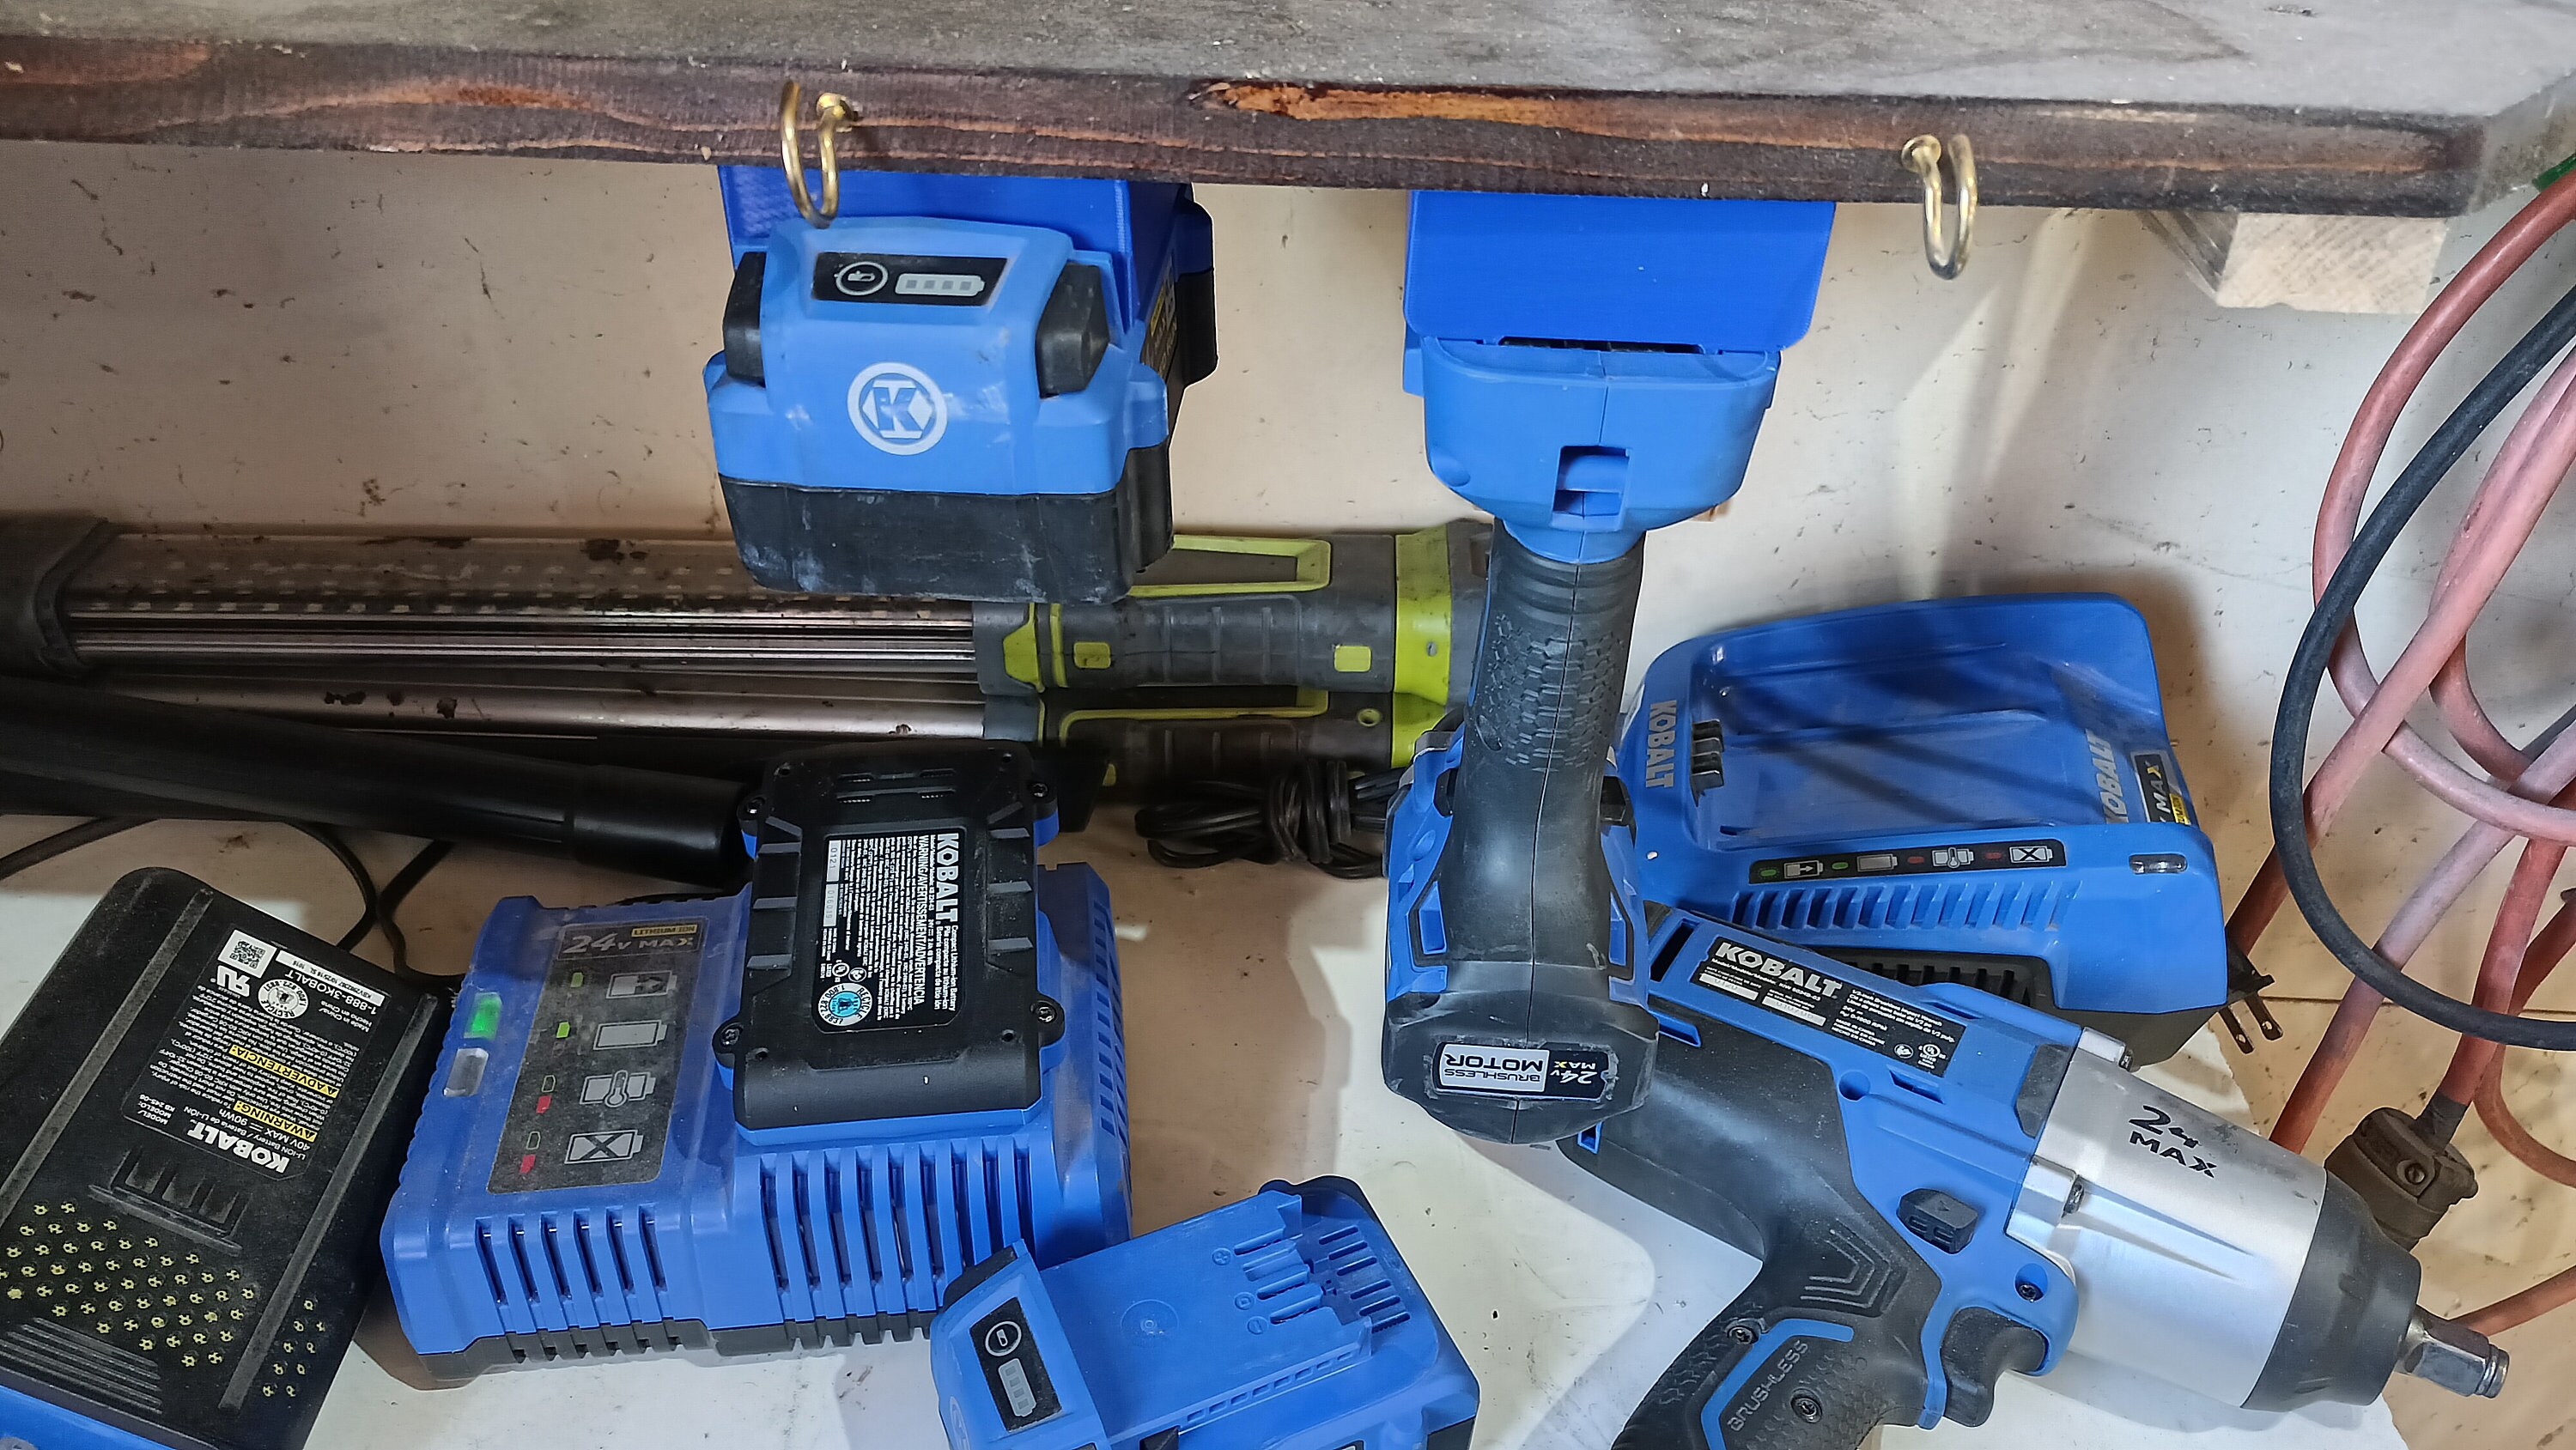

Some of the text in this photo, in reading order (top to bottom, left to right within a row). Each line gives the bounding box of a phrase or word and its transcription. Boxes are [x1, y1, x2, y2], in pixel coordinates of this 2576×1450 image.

[1644, 699, 1677, 789] KOBALT
[2145, 761, 2171, 814] MAX
[829, 846, 837, 871] 0121
[934, 833, 958, 924] KOBALT
[913, 834, 929, 1004] WARNING/AVERTISSEMENT/ADVERTENCIA
[639, 937, 694, 949] MAX
[933, 947, 943, 977] compacta
[948, 925, 958, 1011] Compact Lithium-ion Battery
[1715, 941, 1844, 999] KOBALT
[934, 977, 942, 986] de
[283, 968, 379, 1016] 1-888-3KOBALT
[260, 999, 295, 1016] RECYCLE
[319, 999, 341, 1013] China
[817, 985, 844, 1023] 1.800.822.8837
[856, 988, 871, 1018] RECYCLE
[318, 1005, 343, 1021] China/
[349, 1013, 372, 1027] Hecho
[349, 1019, 369, 1032] Made
[156, 1059, 168, 1068] Do
[185, 1059, 212, 1073] between
[195, 1056, 206, 1065] Do
[212, 1057, 232, 1068] above
[221, 1053, 240, 1065] reach
[1443, 1053, 1544, 1072] MOTOR
[1553, 1060, 1596, 1071] MAX
[224, 1068, 238, 1077] and
[230, 1045, 325, 1091] ADVERTENCIA:
[231, 1065, 246, 1074] heat
[256, 1068, 280, 1082] battery
[149, 1063, 235, 1102] user must read the instruction
[197, 1077, 215, 1088] short
[216, 1071, 253, 1091] temperature
[236, 1072, 266, 1089] explosion
[1444, 1068, 1540, 1083] BRUSHLESS
[177, 1082, 191, 1091] risk
[228, 1083, 242, 1092] with
[278, 1077, 296, 1089] Keep
[189, 1087, 202, 1095] the
[241, 1088, 257, 1098] only
[252, 1086, 266, 1095] sure
[264, 1092, 283, 1102] make
[200, 1092, 223, 1105] reduce
[222, 1101, 233, 1109] To
[234, 1092, 270, 1110] protection.
[254, 1095, 269, 1103] Use
[137, 1100, 172, 1119] MODELO:
[163, 1103, 175, 1112] KB
[182, 1105, 210, 1121] LI-IÓN
[268, 1106, 281, 1114] eye
[280, 1105, 294, 1113] into
[137, 1107, 168, 1125] MODEL/
[208, 1115, 221, 1125] de
[234, 1101, 307, 1137] WARNING:
[279, 1111, 297, 1122] Wear
[293, 1110, 312, 1121] throw
[307, 1110, 325, 1121] When
[216, 1107, 311, 1152] 40V MAX 90Wh
[219, 1120, 247, 1136] Batería
[185, 1119, 290, 1174] KOBALT
[252, 1132, 282, 1150] Battery
[280, 1145, 306, 1160] LI-ION
[2129, 1131, 2218, 1179] MAX
[1727, 1339, 1809, 1433] BRUSHLESS
